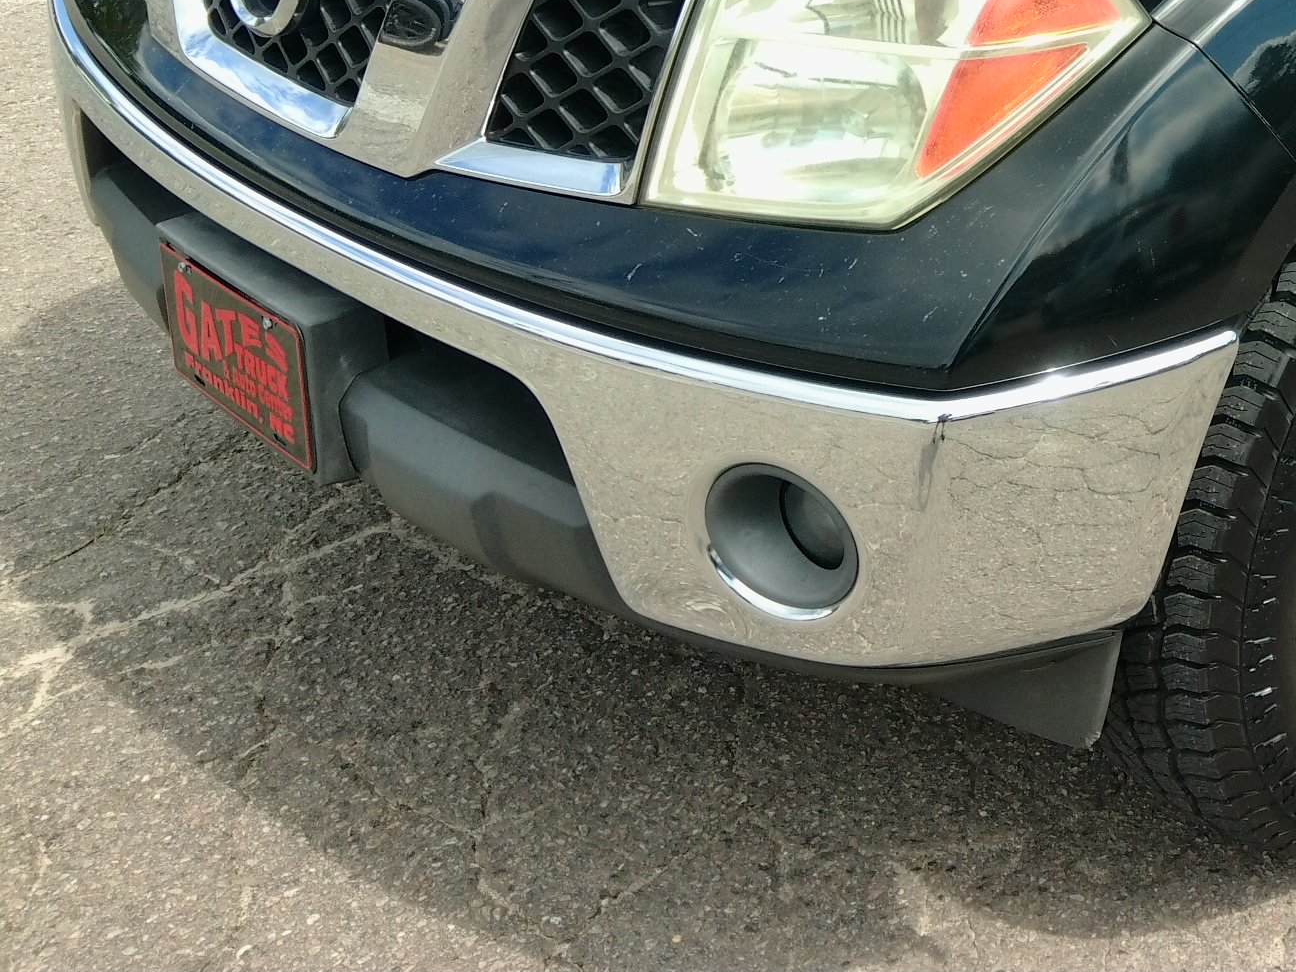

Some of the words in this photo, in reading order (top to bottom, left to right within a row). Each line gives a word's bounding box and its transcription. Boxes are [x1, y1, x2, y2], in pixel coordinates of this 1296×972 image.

[174, 270, 289, 373] GATES
[184, 351, 265, 424] Franklin,
[270, 412, 296, 444] NC
[234, 343, 290, 400] TRUCK
